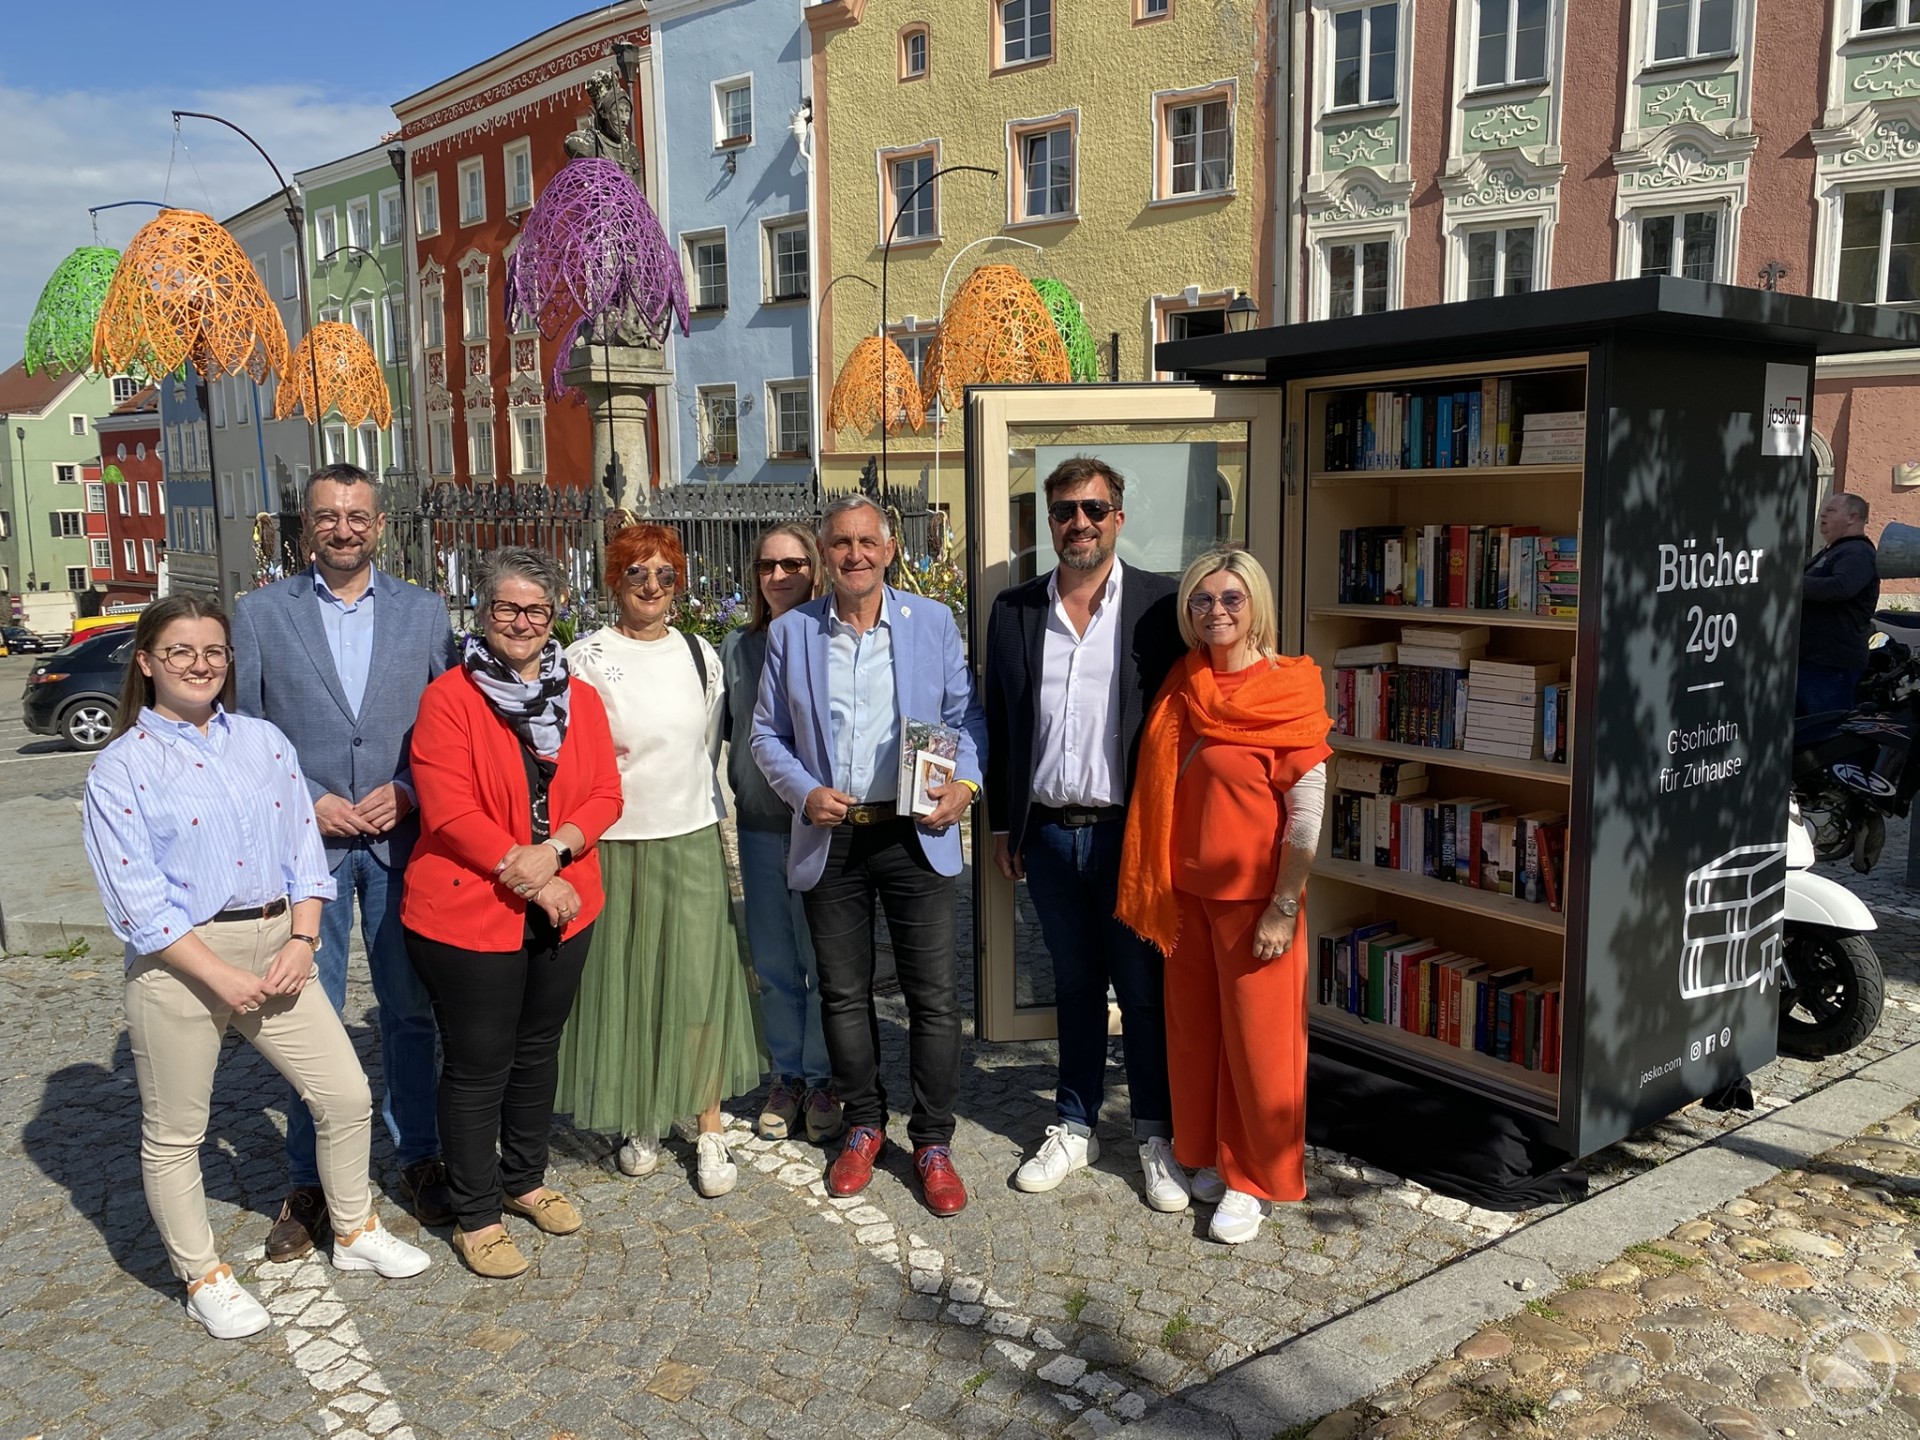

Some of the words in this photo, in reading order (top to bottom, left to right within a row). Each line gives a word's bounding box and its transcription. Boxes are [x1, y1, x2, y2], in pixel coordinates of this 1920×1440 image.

[1767, 403, 1798, 428] josko
[1656, 537, 1764, 593] Bücher
[1685, 605, 1738, 664] 2go
[1667, 720, 1739, 755] G'schichtn
[1659, 768, 1680, 794] für
[1683, 756, 1742, 788] Zuhause
[1443, 843, 1451, 866] GODS
[1639, 1056, 1682, 1089] josko.com
